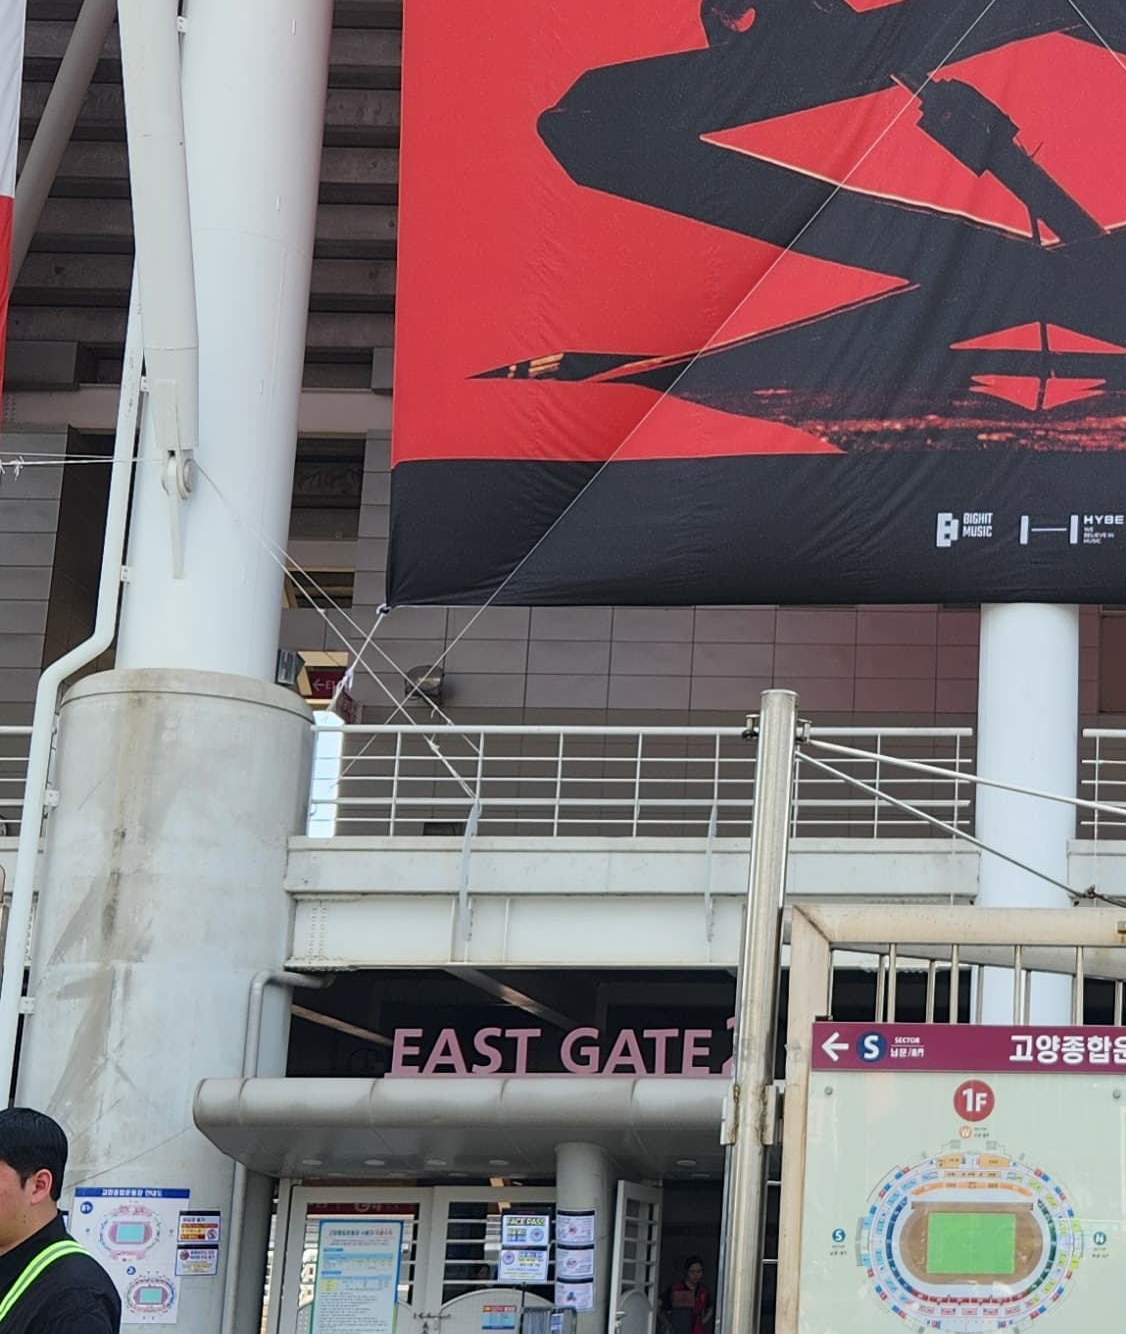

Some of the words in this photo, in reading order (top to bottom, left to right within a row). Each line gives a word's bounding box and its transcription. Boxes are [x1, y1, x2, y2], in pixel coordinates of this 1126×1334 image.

[1083, 514, 1125, 525] HYBE
[962, 525, 993, 538] MUSIC
[863, 1035, 880, 1060] S
[894, 1036, 921, 1044] SECTOR
[391, 1027, 542, 1075] EAST
[560, 1027, 712, 1075] GATE
[962, 1087, 988, 1113] 1F
